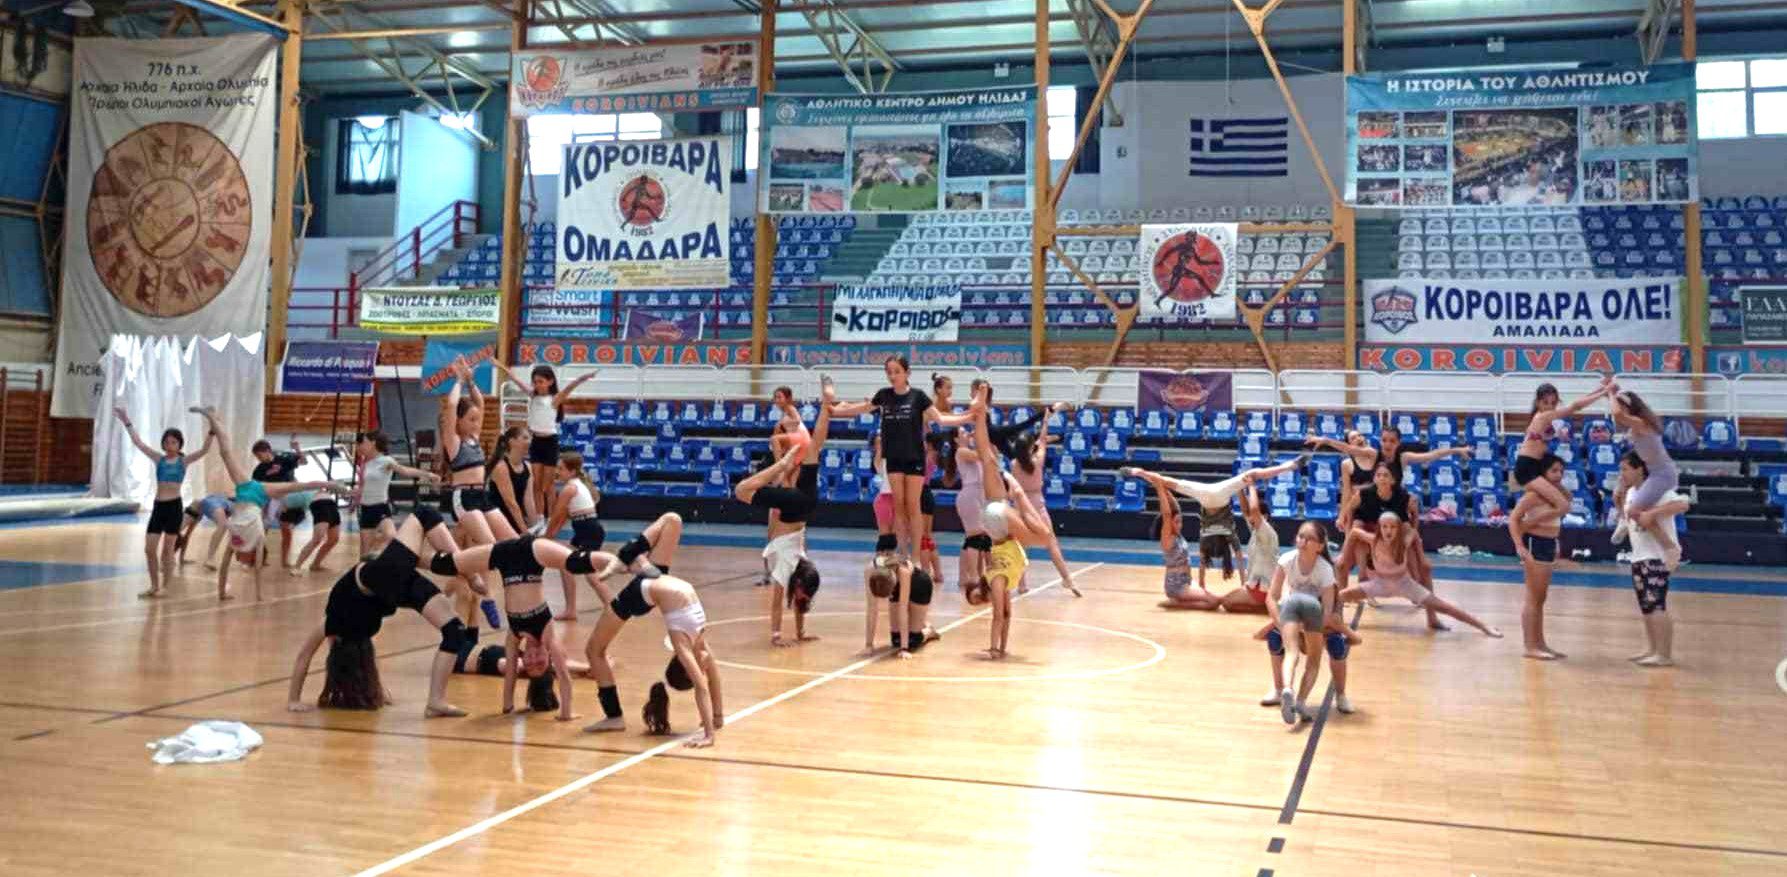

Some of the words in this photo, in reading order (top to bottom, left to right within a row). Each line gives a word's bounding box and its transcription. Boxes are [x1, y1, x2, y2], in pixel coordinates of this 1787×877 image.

[147, 62, 172, 77] 776
[1388, 80, 1399, 93] Η
[1405, 78, 1474, 93] ΙΣΤΟΡΙΑ
[1480, 75, 1516, 91] ΤΟΥ
[1522, 70, 1650, 90] ΑΘΛΗΤΙΣΜΟΥ
[807, 97, 872, 109] ΑΘΛΗΤΙΚΟ
[876, 96, 923, 108] ΚΕΝΤΡΟ
[927, 94, 973, 107] ΔΗΜΟΥ
[978, 91, 1027, 105] ΗΛΙΔΑΣ
[564, 140, 723, 198] ΚΟΡΟΙΒΑΡΑ
[563, 221, 723, 262] ΟΜΑΔΑΡΑ
[1425, 285, 1593, 321] ΚΟΡΟΙΒΑΡΑ
[1602, 283, 1673, 321] ΟΛΕ!
[1492, 325, 1600, 338] ΑΜΑΛΙΑΔΑ
[519, 344, 752, 366] KOROIVIANS
[1359, 347, 1685, 372] KOROIVIANS
